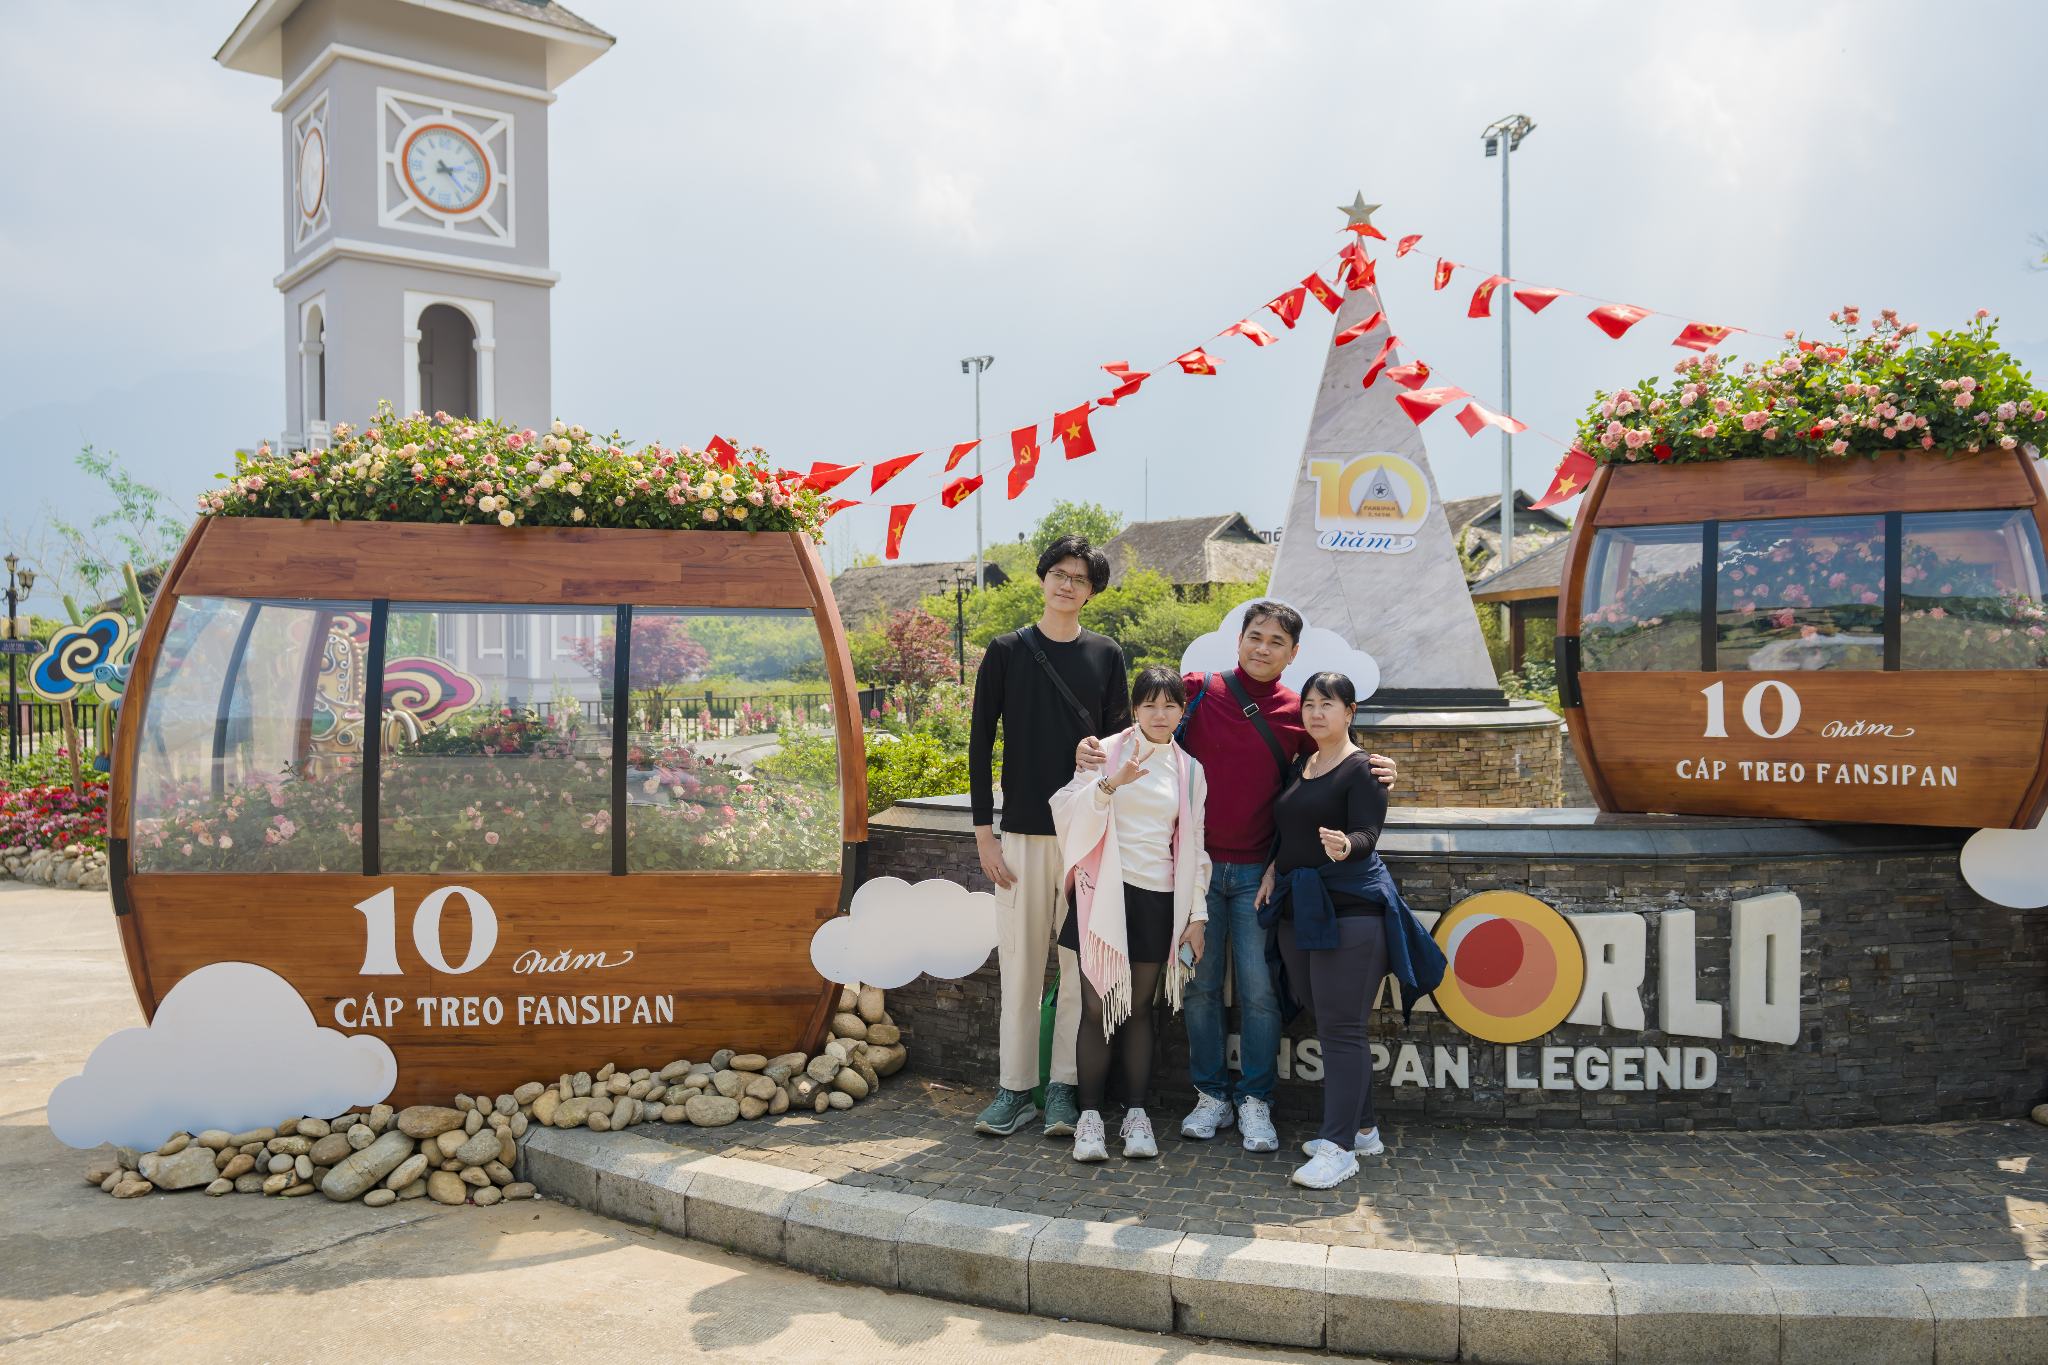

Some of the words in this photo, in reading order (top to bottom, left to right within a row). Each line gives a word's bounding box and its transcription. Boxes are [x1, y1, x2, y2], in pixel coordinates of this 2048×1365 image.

[1310, 455, 1427, 523] 10
[1700, 680, 1801, 738] 10
[1676, 757, 1727, 780] CÁP
[1738, 761, 1805, 783] TREO
[1817, 763, 1958, 787] FANSIPAN
[353, 885, 498, 975] 10
[334, 992, 404, 1028] CÁP
[417, 996, 504, 1027] TREO
[518, 994, 674, 1026] FANSIPAN
[1505, 1045, 1718, 1091] LEGEND
